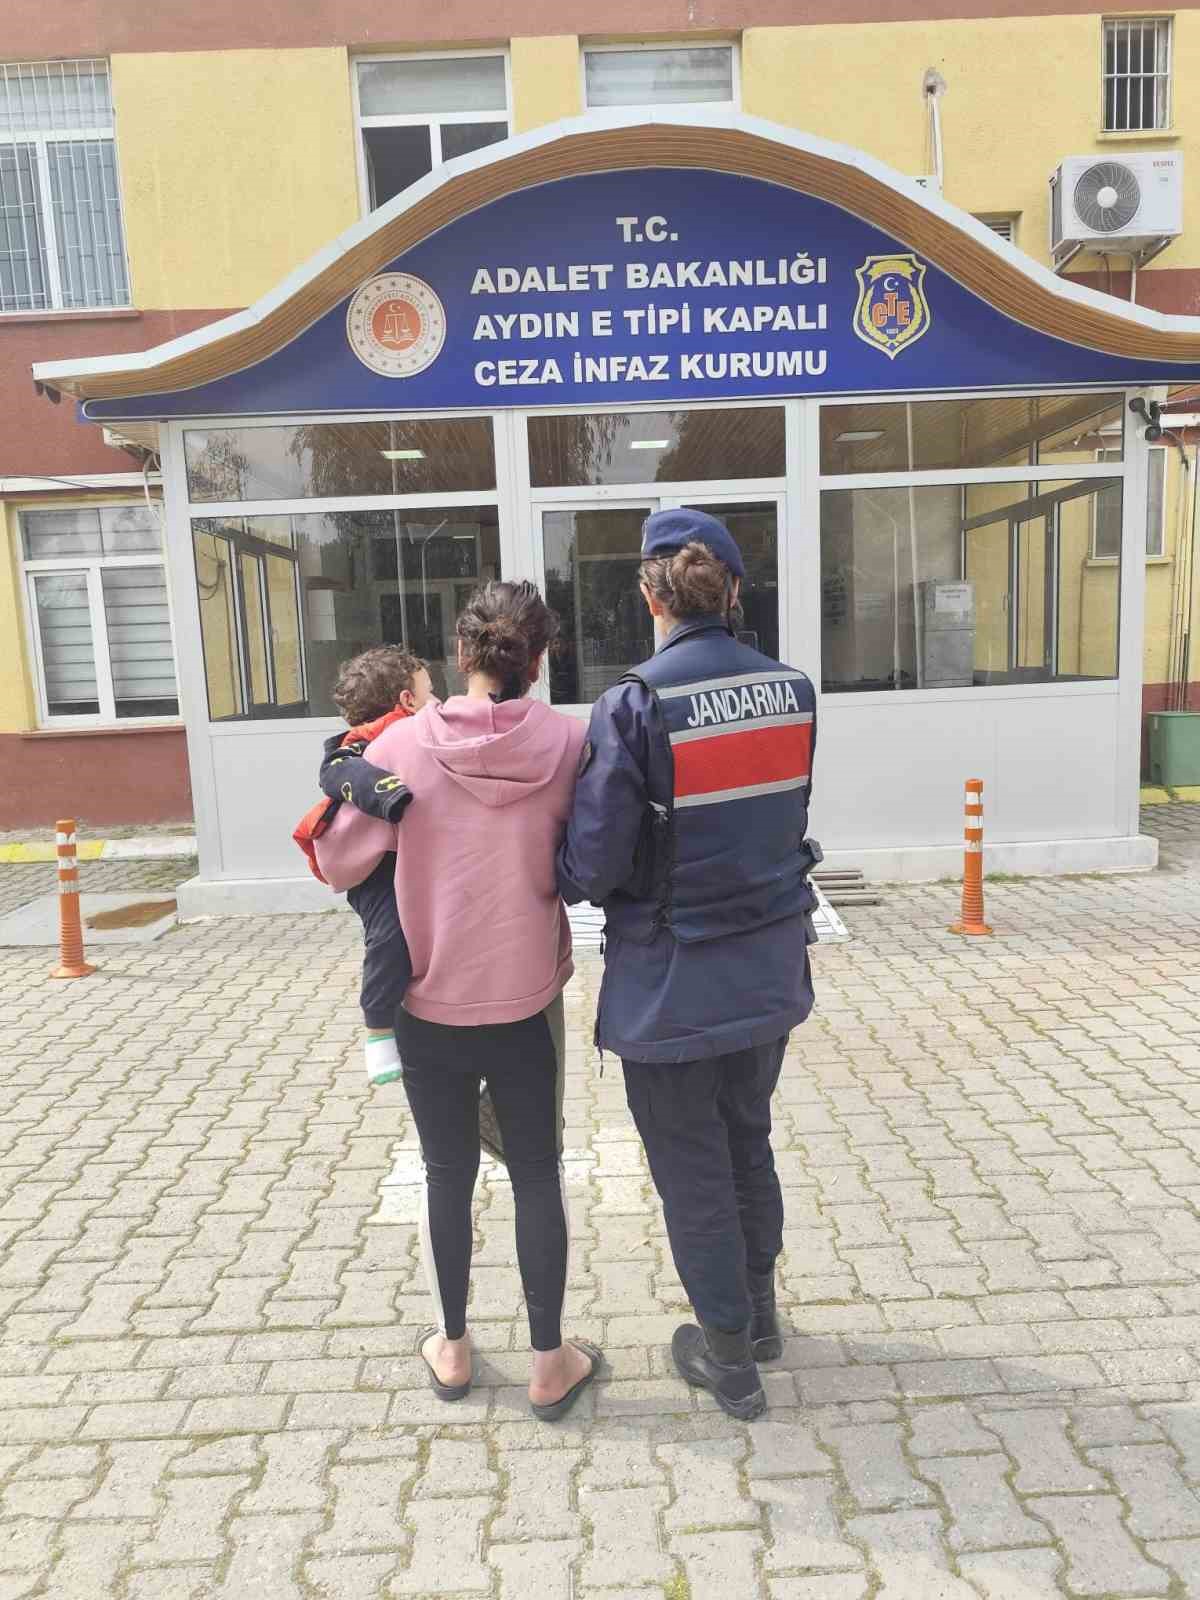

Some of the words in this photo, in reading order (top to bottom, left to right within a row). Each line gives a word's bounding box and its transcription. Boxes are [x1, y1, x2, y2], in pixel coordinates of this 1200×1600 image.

[616, 216, 679, 243] T.C.
[470, 264, 614, 294] ADALET
[626, 252, 827, 289] BAKANLIĞI
[473, 312, 579, 340] AYDIN
[592, 311, 613, 336] E
[623, 303, 690, 335] TİPİ
[703, 304, 827, 333] KAPALI
[474, 358, 564, 386] CEZA
[573, 352, 670, 383] İNFAZ
[680, 350, 827, 379] KURUMU
[687, 681, 799, 727] JANDARMA
